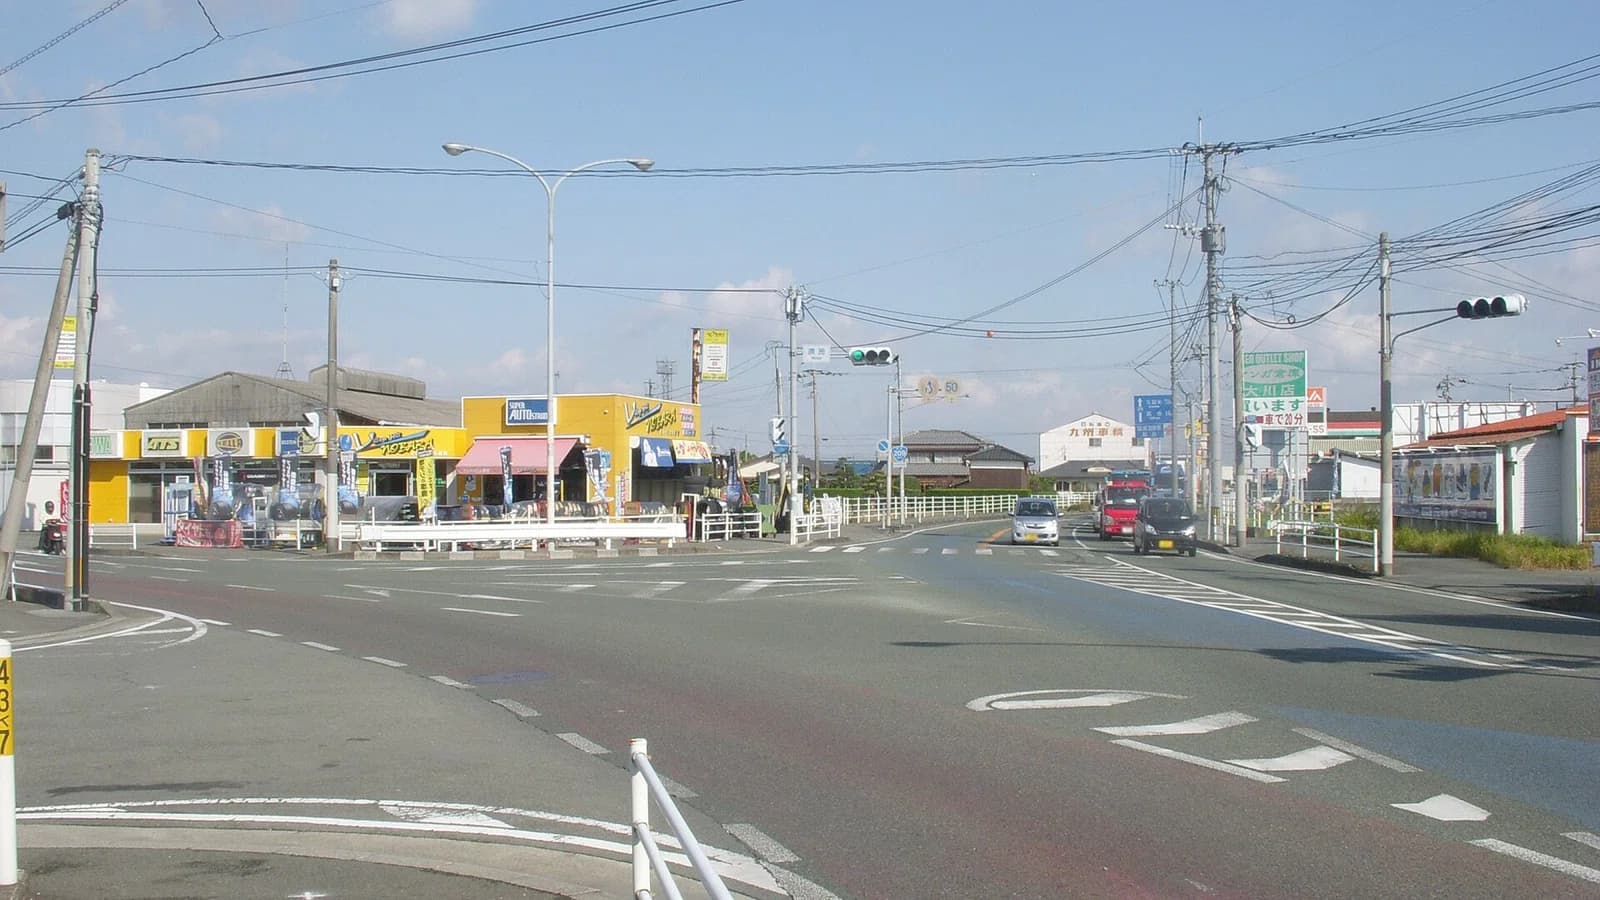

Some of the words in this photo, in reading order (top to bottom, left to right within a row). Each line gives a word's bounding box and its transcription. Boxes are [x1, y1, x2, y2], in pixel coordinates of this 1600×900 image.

[945, 382, 958, 392] 50
[1245, 384, 1296, 396] 大川店
